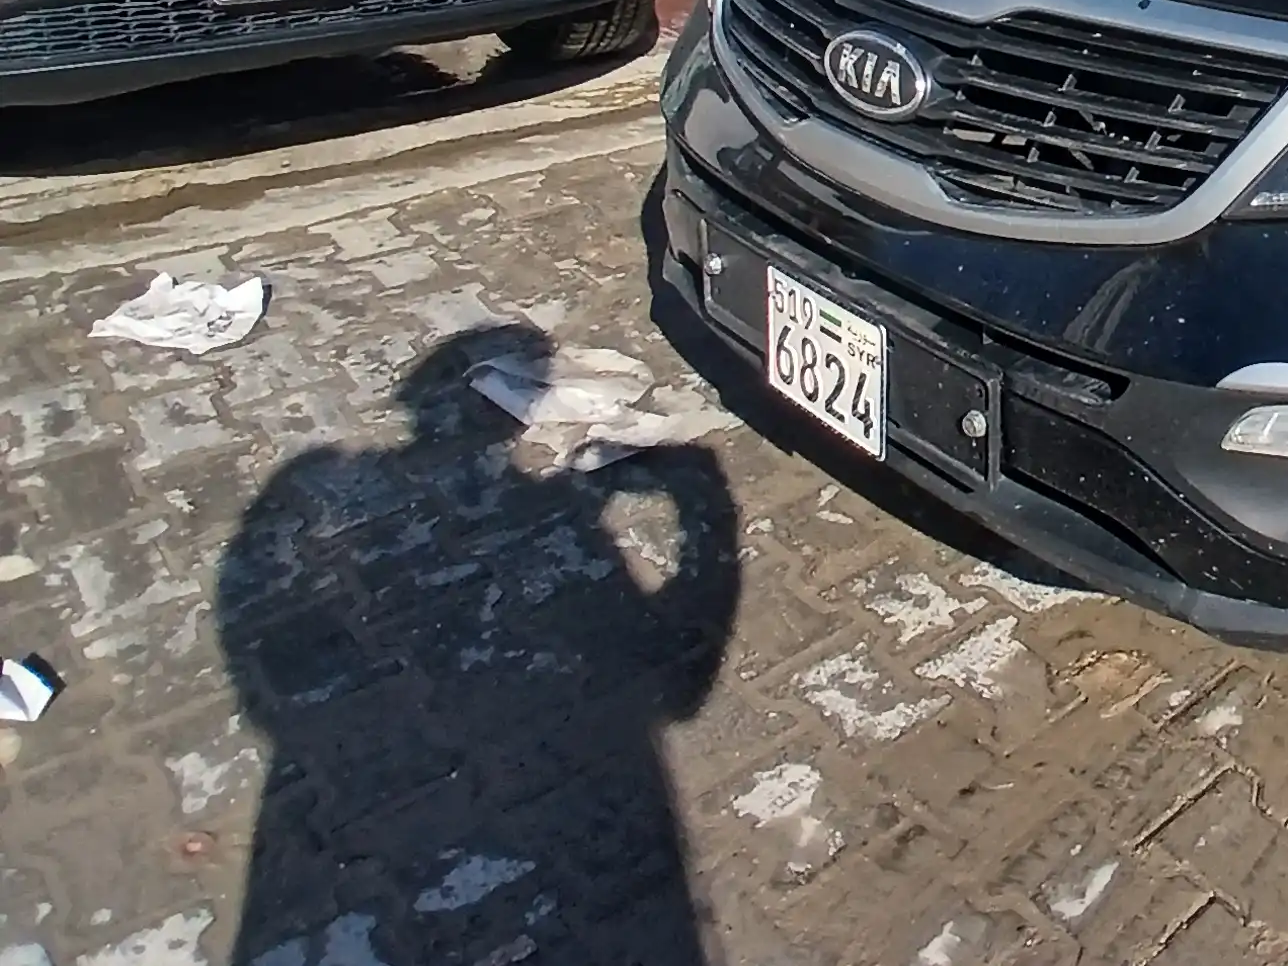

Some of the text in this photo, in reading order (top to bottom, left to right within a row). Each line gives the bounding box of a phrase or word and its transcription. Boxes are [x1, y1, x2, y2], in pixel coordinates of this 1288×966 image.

[837, 42, 901, 106] KIA
[773, 279, 816, 330] 519
[776, 325, 874, 439] 6824
[847, 342, 876, 369] SYR
